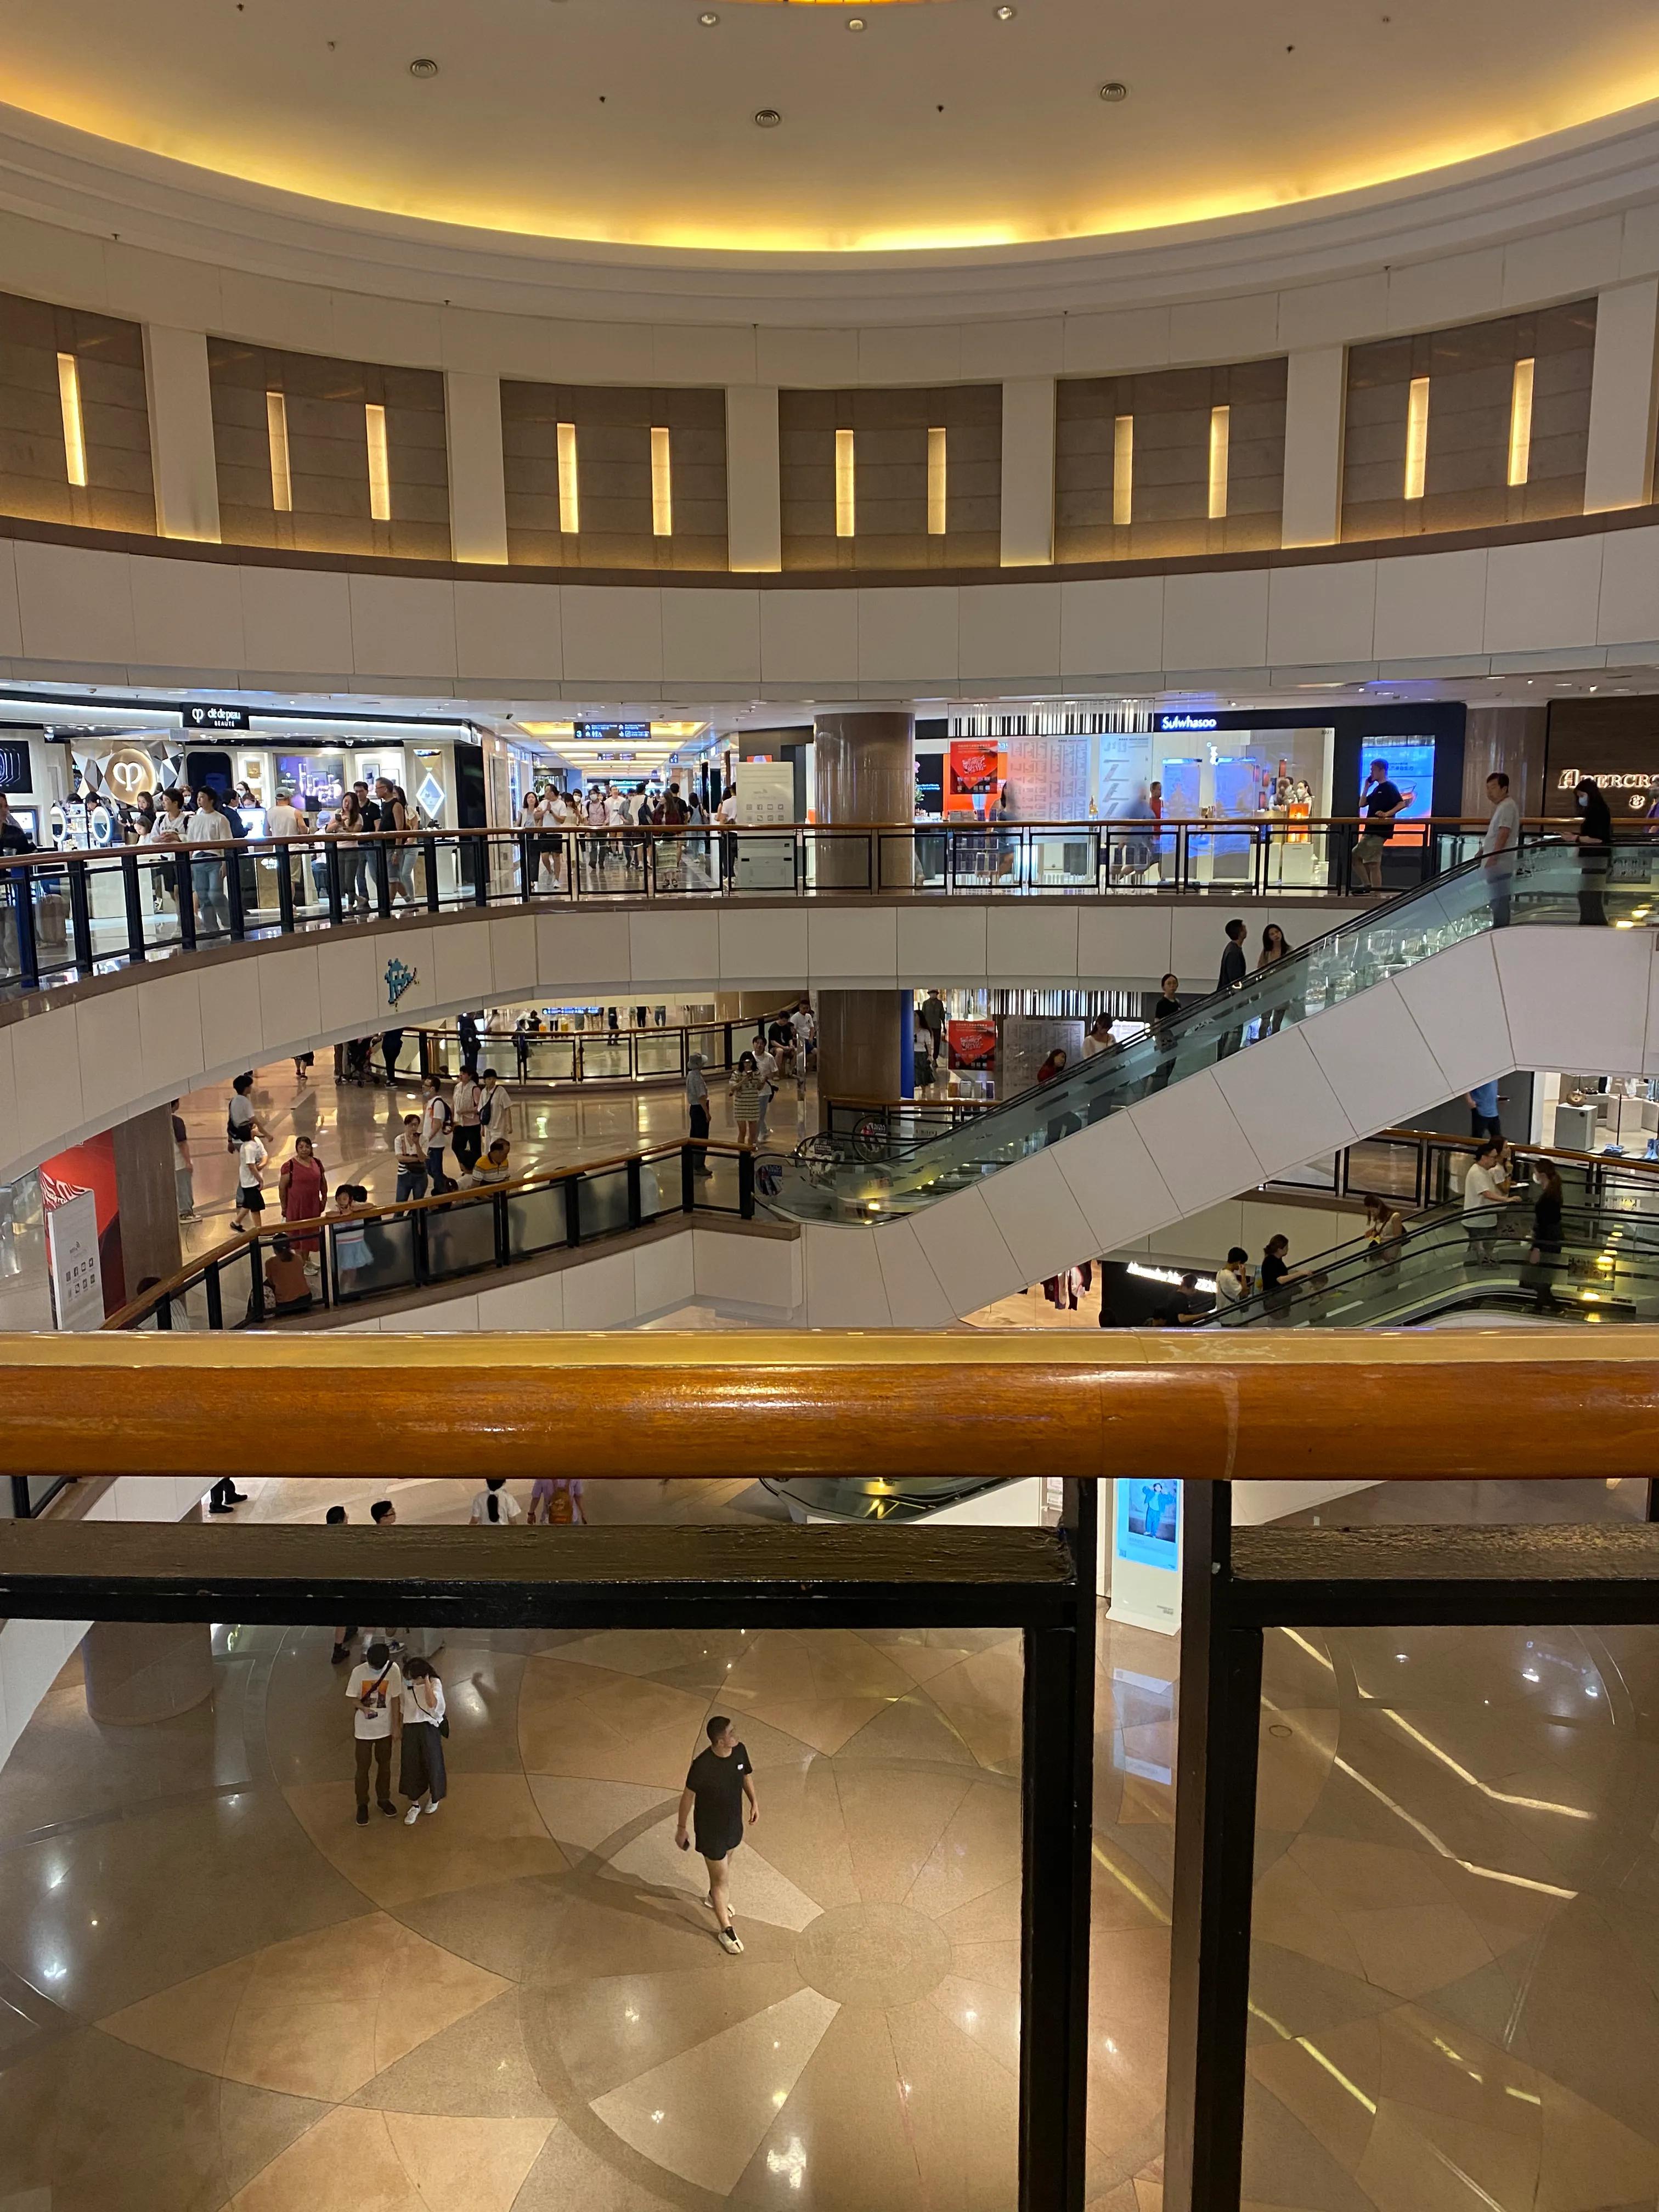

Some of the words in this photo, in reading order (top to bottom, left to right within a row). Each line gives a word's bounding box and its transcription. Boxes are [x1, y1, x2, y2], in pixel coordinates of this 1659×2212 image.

[1162, 715, 1217, 729] Sulwhasoo
[1558, 769, 1659, 788] AERCR
[1628, 794, 1645, 809] &
